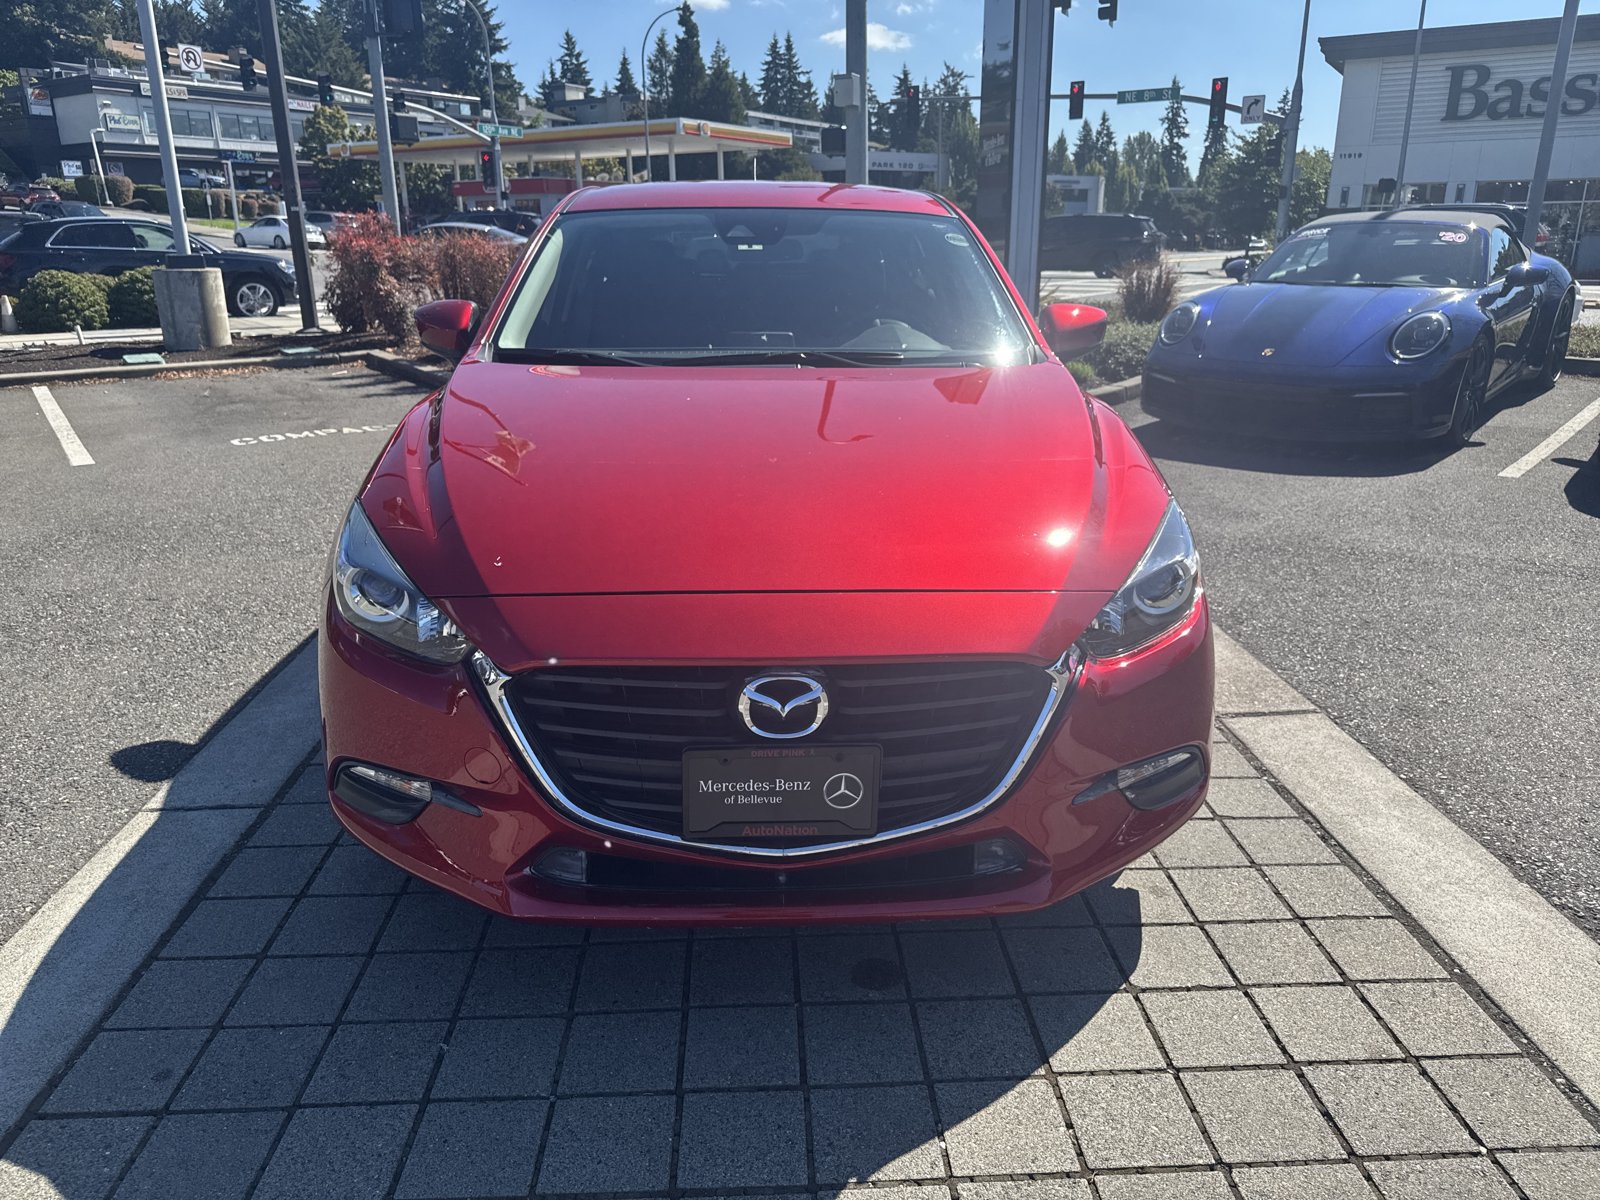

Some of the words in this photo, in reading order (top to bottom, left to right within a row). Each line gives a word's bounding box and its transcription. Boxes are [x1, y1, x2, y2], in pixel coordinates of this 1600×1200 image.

[1125, 91, 1137, 102] NE
[1144, 90, 1157, 101] 8th
[1162, 89, 1172, 100] St
[752, 749, 780, 758] DRIVE
[782, 749, 807, 757] PINK
[698, 778, 812, 793] Mercedes-Benz
[724, 795, 735, 804] of
[737, 795, 783, 804] Bellevue
[742, 825, 818, 837] AutoNation
